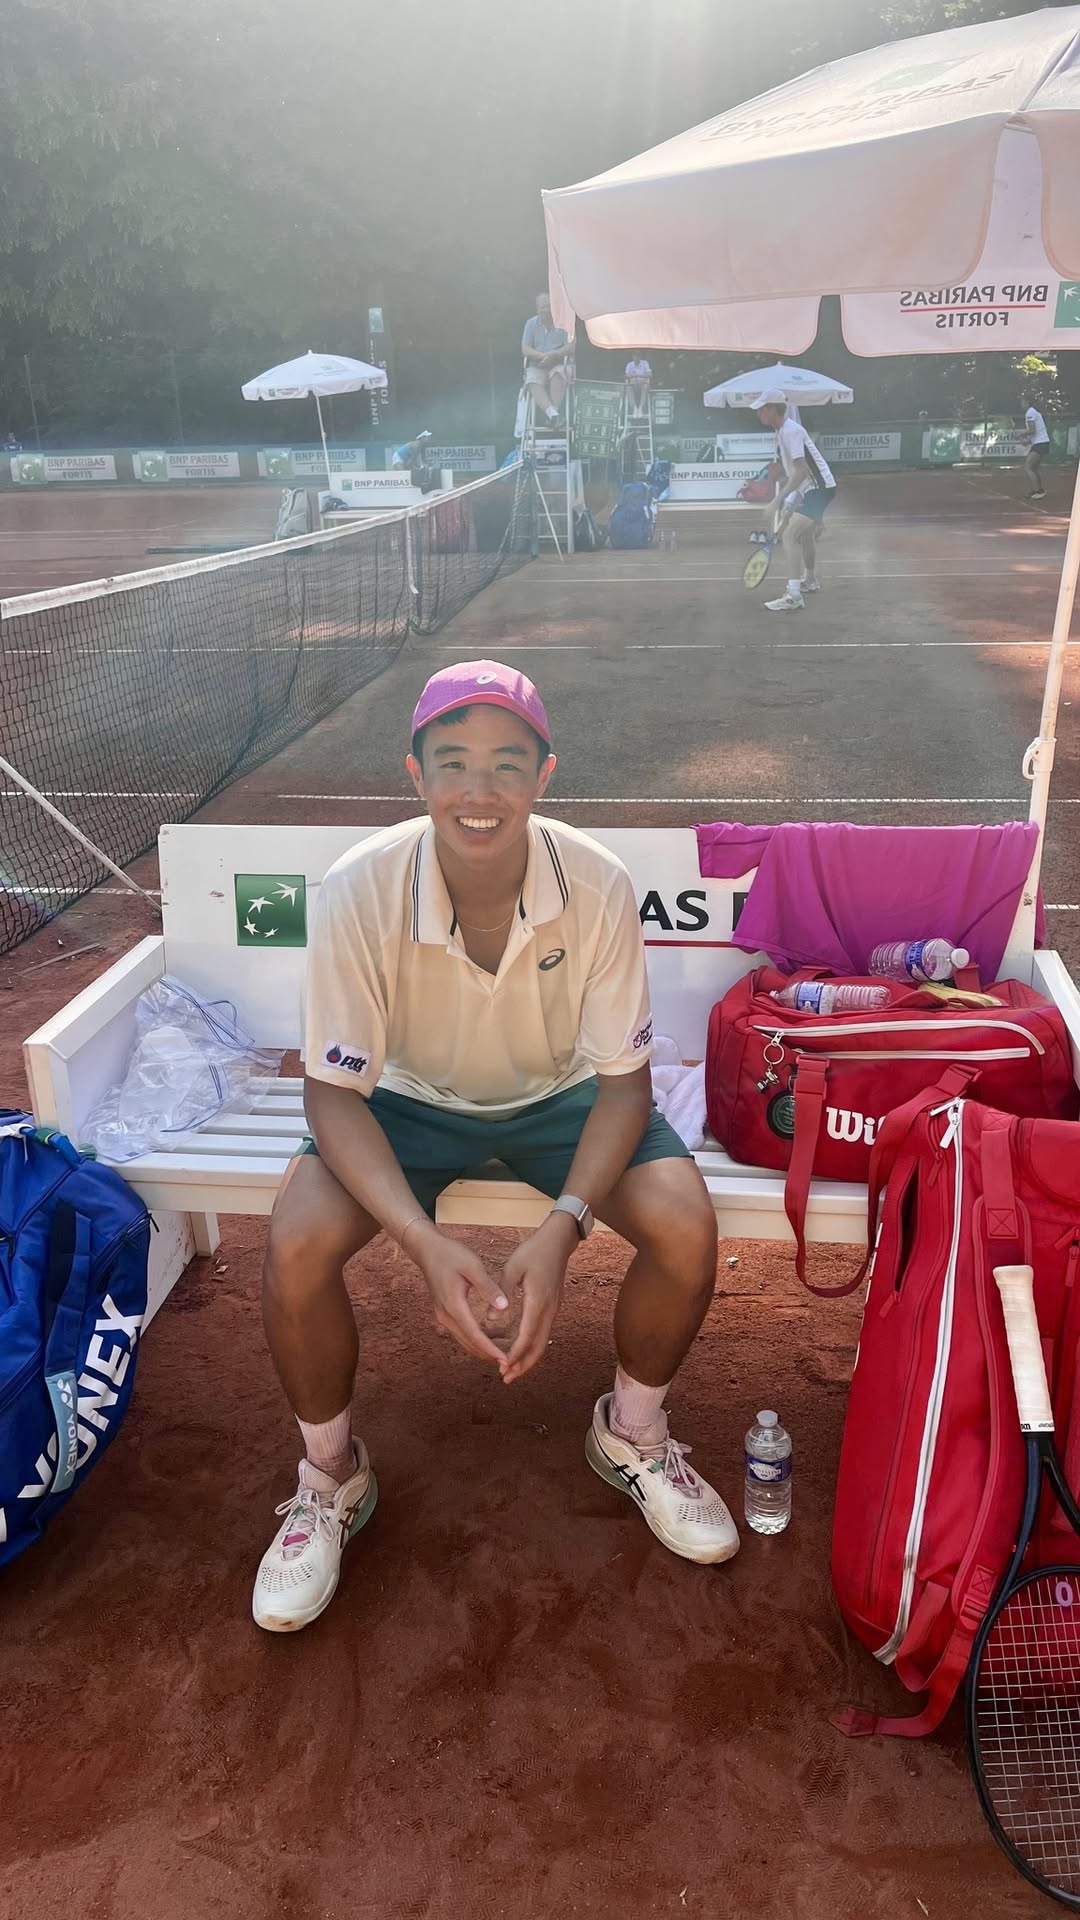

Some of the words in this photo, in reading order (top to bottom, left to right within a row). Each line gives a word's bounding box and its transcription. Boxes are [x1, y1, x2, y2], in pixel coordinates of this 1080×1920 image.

[823, 436, 845, 446] BNP
[847, 434, 890, 445] PARIBAS
[445, 447, 486, 457] PARIBAS
[838, 450, 873, 459] FORTIS
[981, 445, 1016, 455] FORTIS
[190, 454, 229, 464] PARIBAS
[691, 471, 730, 479] PARIBAS
[354, 480, 372, 488] BNP
[373, 479, 410, 488] PARIBAS
[64, 1413, 78, 1476] YONEX
